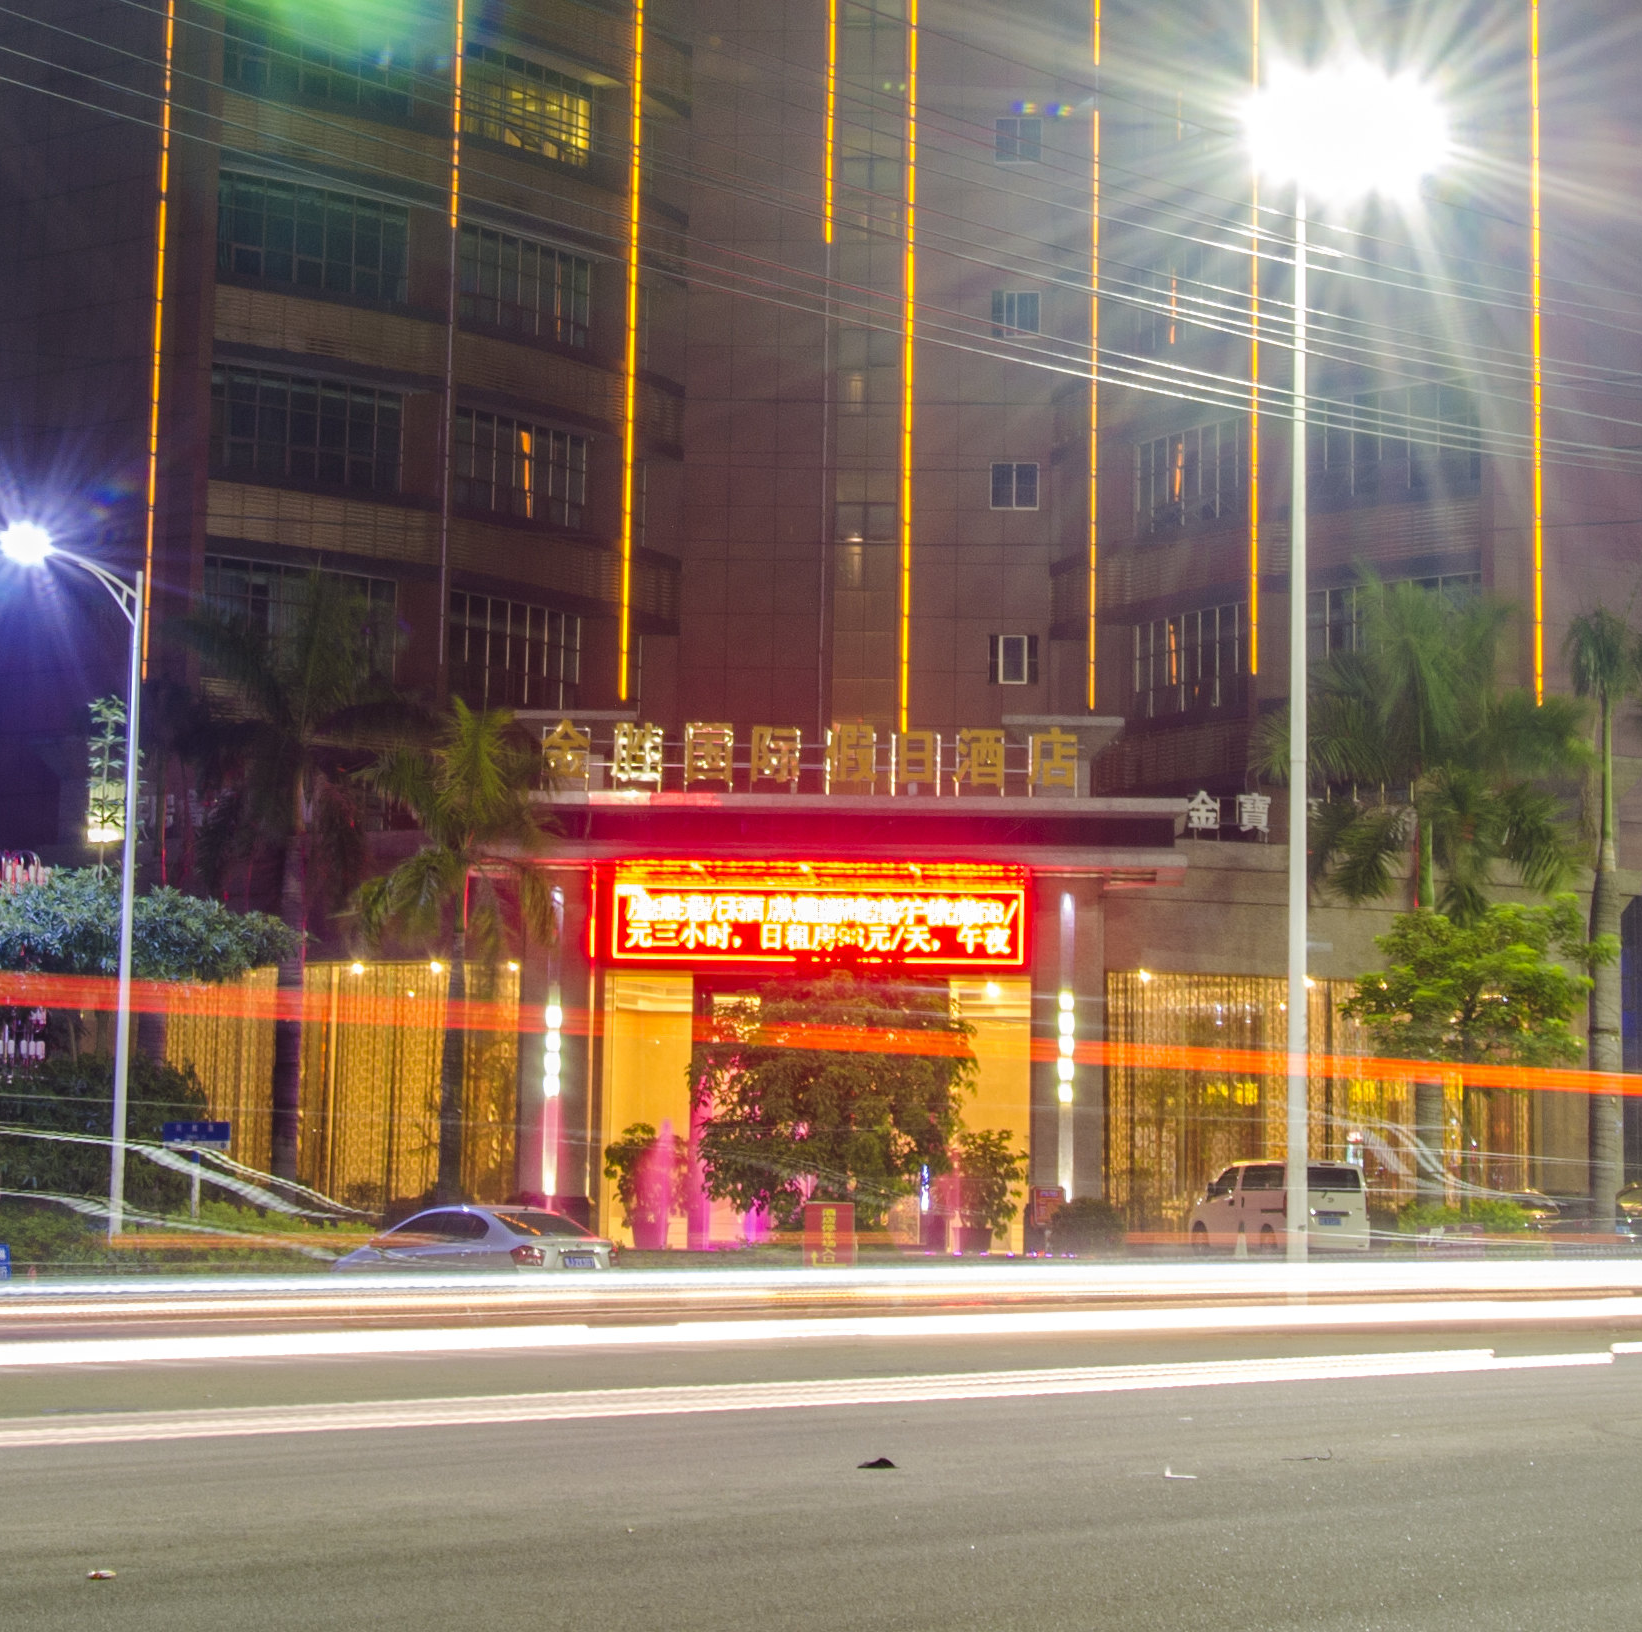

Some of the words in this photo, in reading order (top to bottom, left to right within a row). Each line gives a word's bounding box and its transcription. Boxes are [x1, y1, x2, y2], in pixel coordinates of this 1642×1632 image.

[542, 719, 1078, 789] 金胜国际假日酒店
